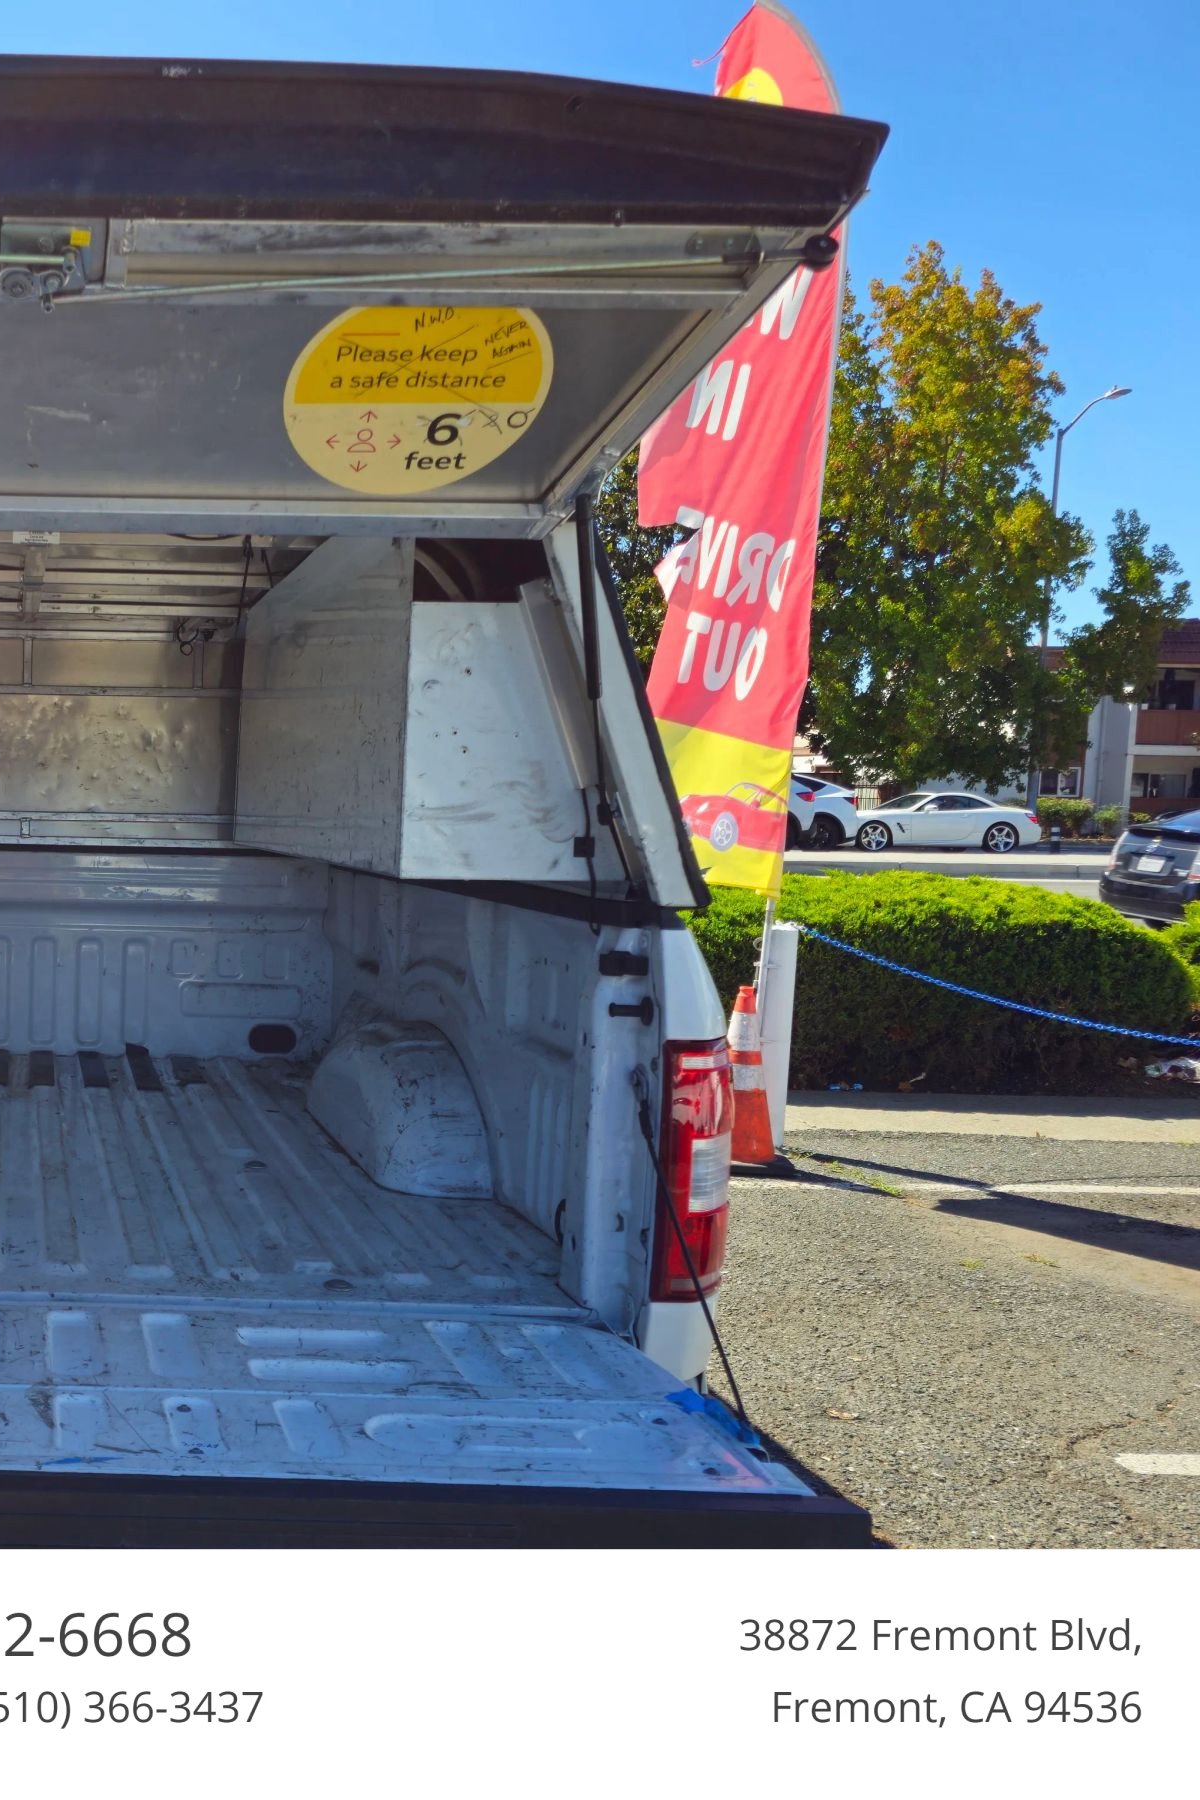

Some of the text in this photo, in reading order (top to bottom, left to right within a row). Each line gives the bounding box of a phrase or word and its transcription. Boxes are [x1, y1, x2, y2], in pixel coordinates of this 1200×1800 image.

[484, 320, 529, 347] NEVER
[336, 345, 478, 366] Please keep
[330, 371, 506, 389] a safe distance
[427, 412, 462, 446] 6
[405, 451, 467, 470] feet
